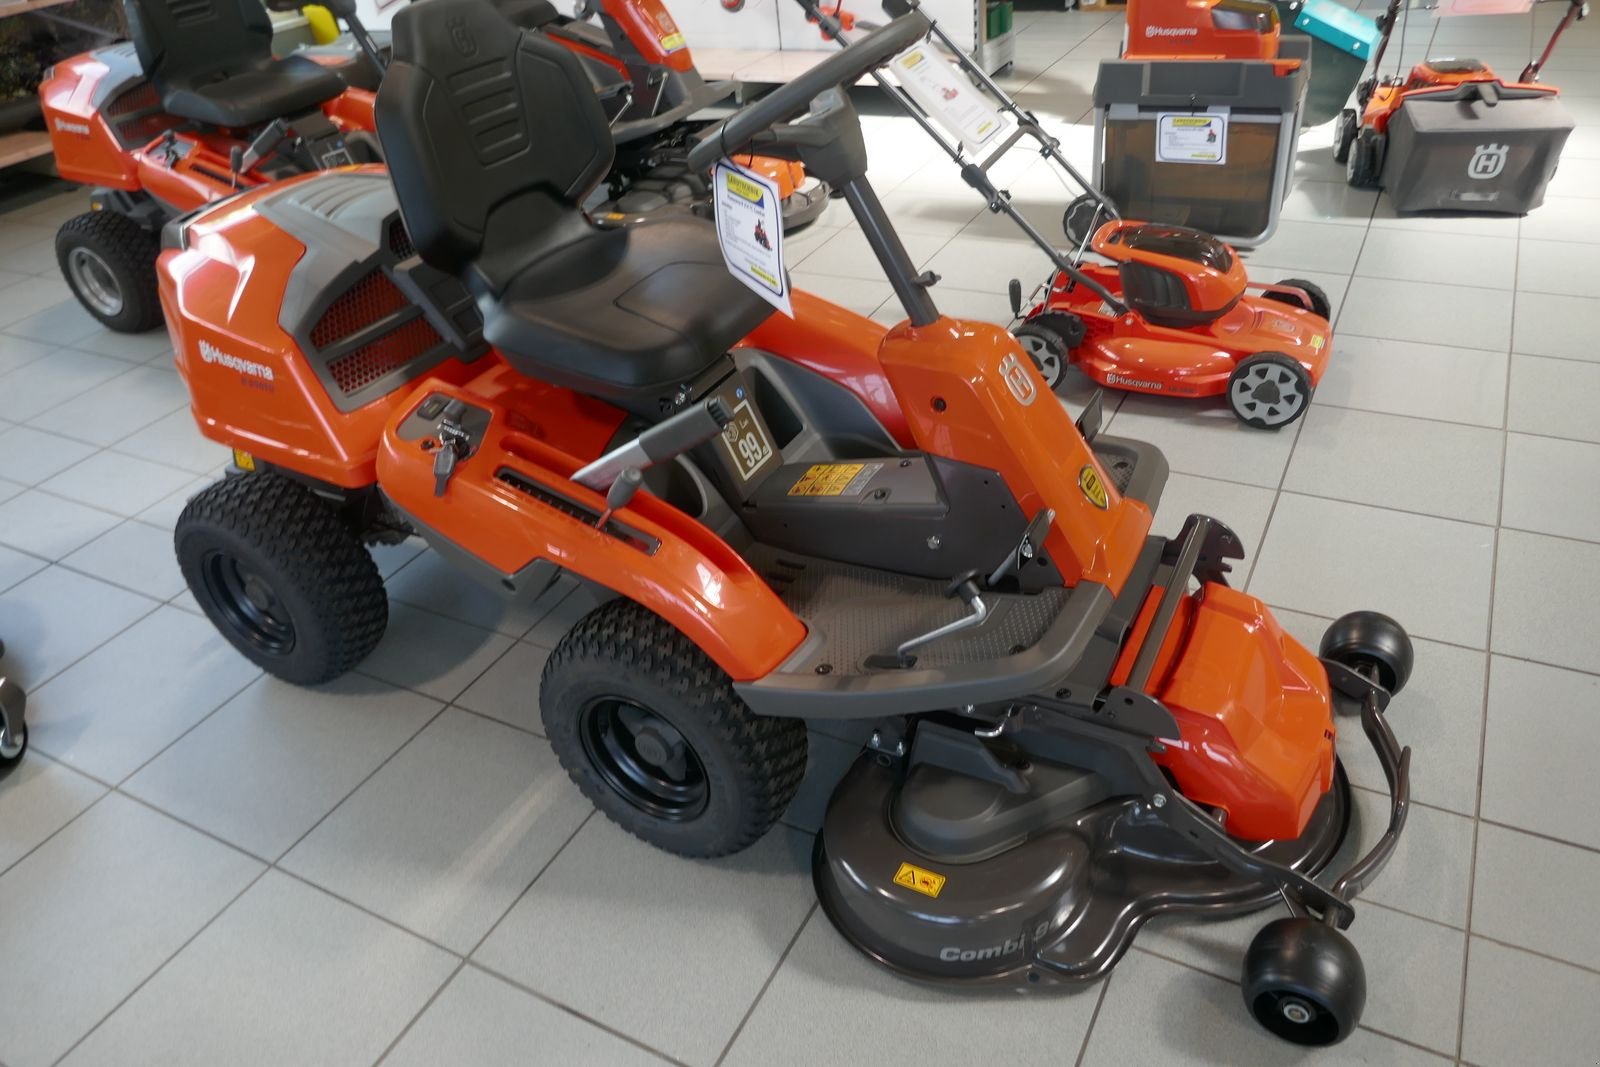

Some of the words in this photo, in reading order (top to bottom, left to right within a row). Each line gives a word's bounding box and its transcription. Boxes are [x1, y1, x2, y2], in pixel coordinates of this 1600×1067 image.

[210, 345, 275, 381] Husqvarna
[1115, 375, 1163, 391] Husqvarna
[738, 431, 763, 468] 99
[939, 933, 1026, 962] Combi
